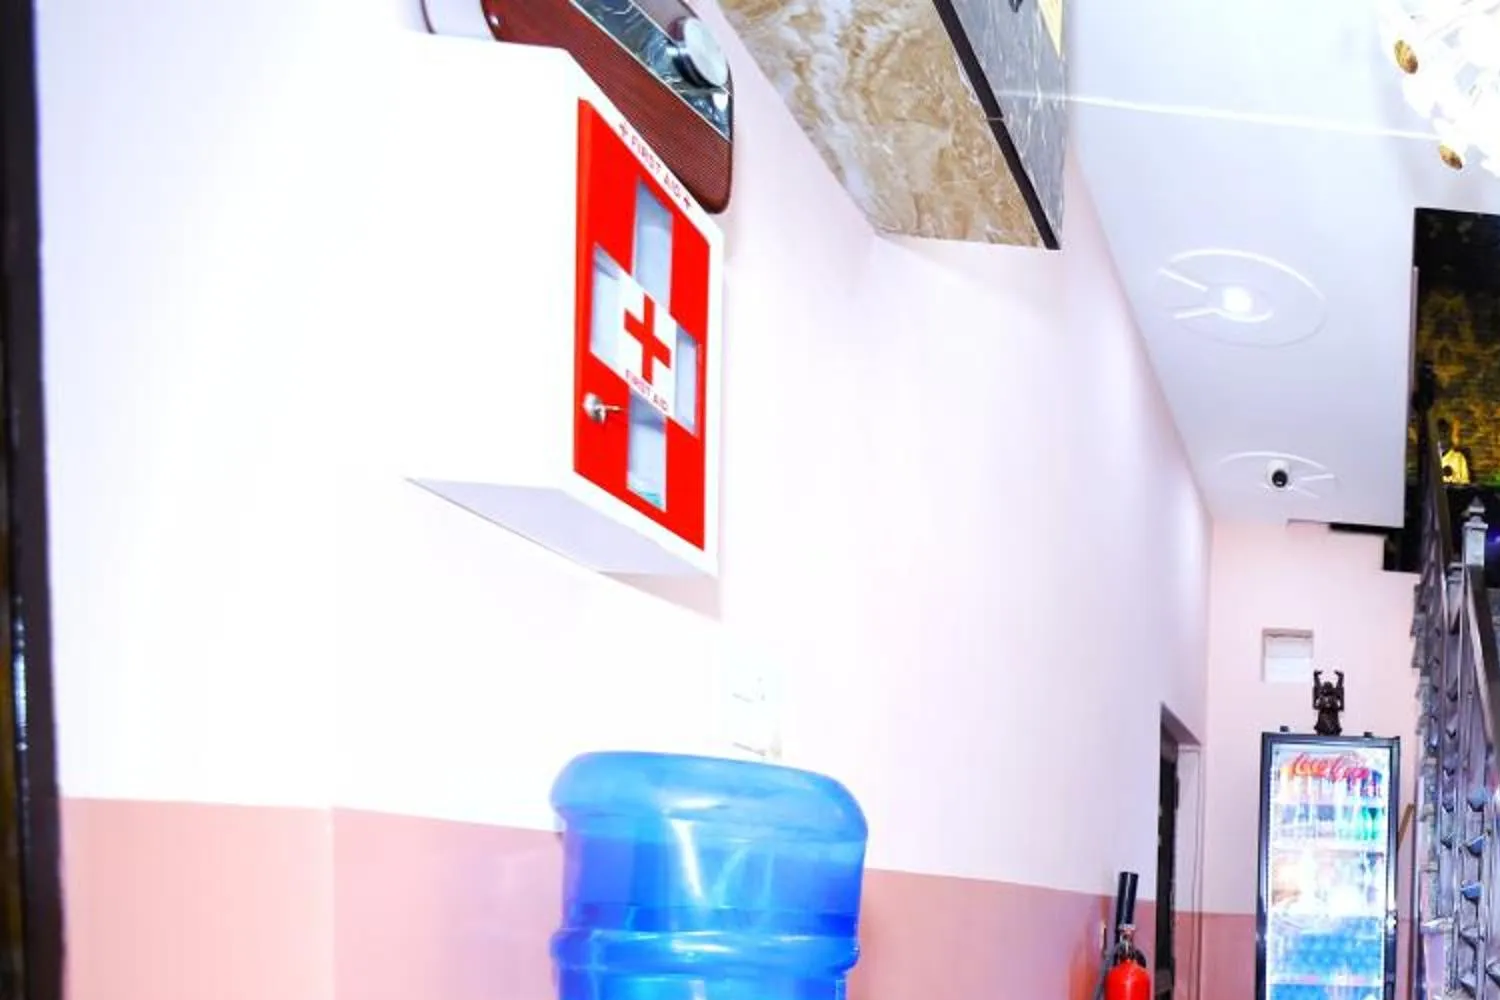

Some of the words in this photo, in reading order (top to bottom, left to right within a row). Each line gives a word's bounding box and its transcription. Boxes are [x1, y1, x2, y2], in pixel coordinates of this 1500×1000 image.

[631, 135, 662, 174] FIRST
[663, 172, 682, 198] AID
[625, 368, 651, 396] FIRST
[652, 392, 669, 411] AID
